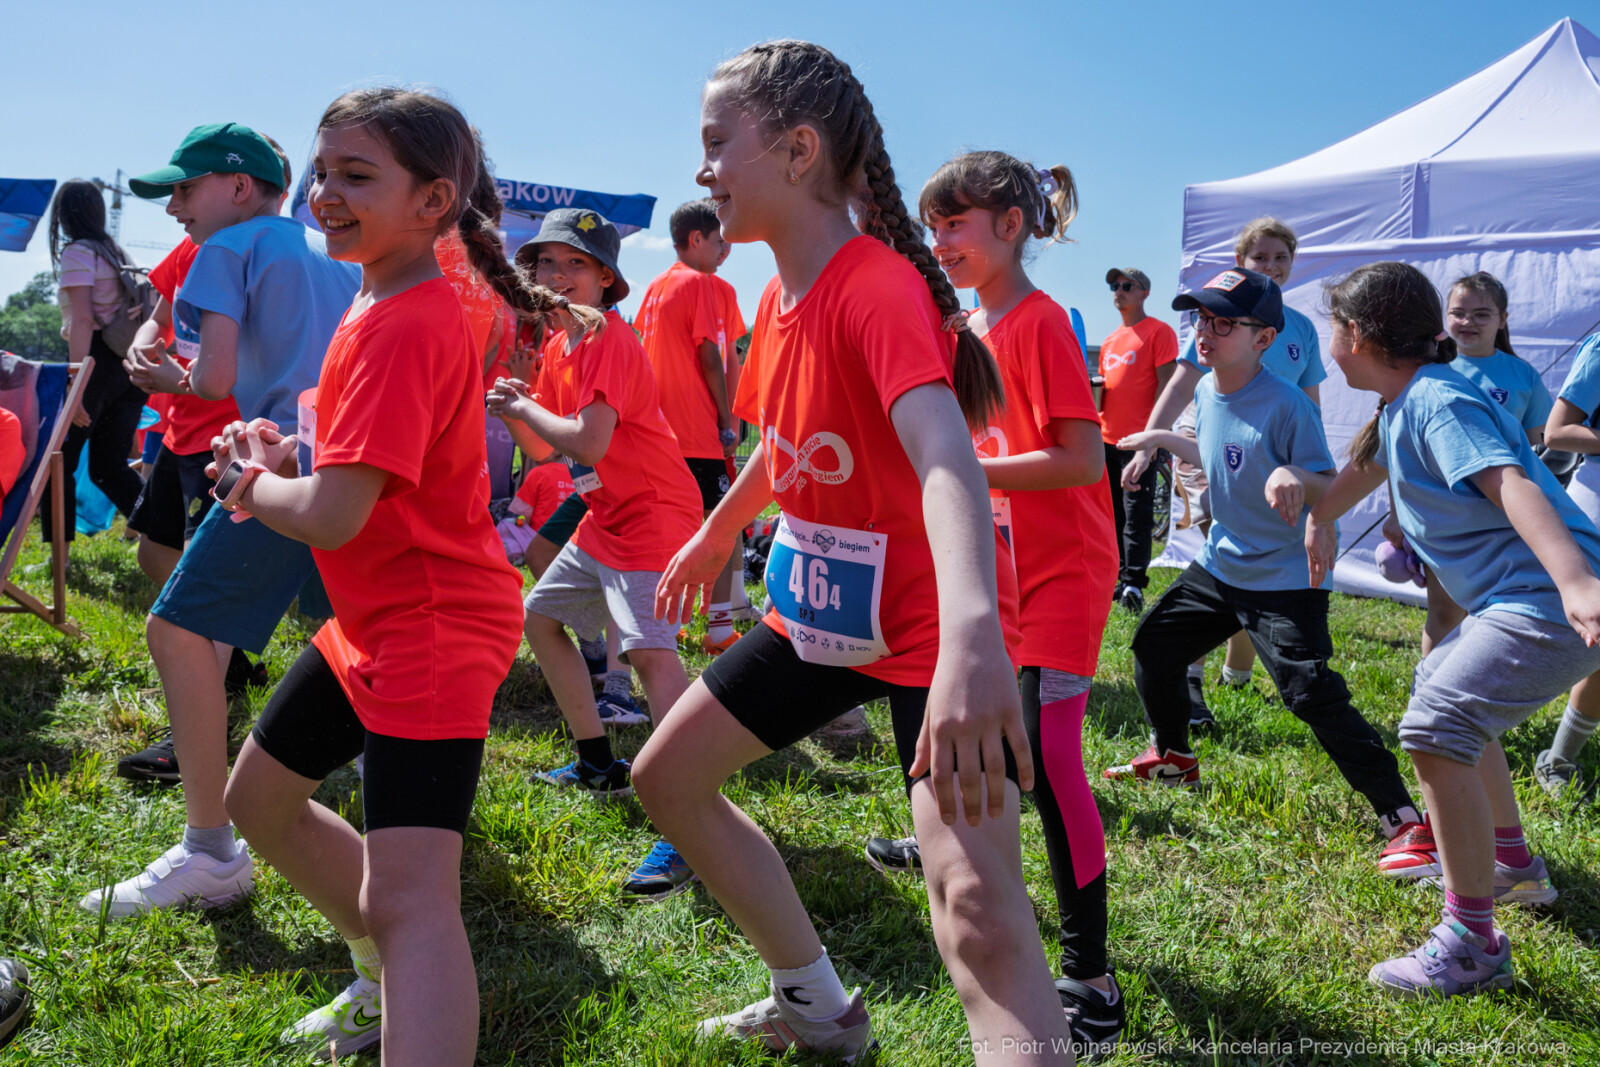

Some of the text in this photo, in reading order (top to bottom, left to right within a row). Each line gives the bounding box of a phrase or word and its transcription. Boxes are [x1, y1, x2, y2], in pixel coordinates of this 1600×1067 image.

[1291, 348, 1298, 358] 3
[1230, 452, 1238, 466] 3
[839, 540, 870, 553] biegiem
[799, 607, 815, 622] SP 3
